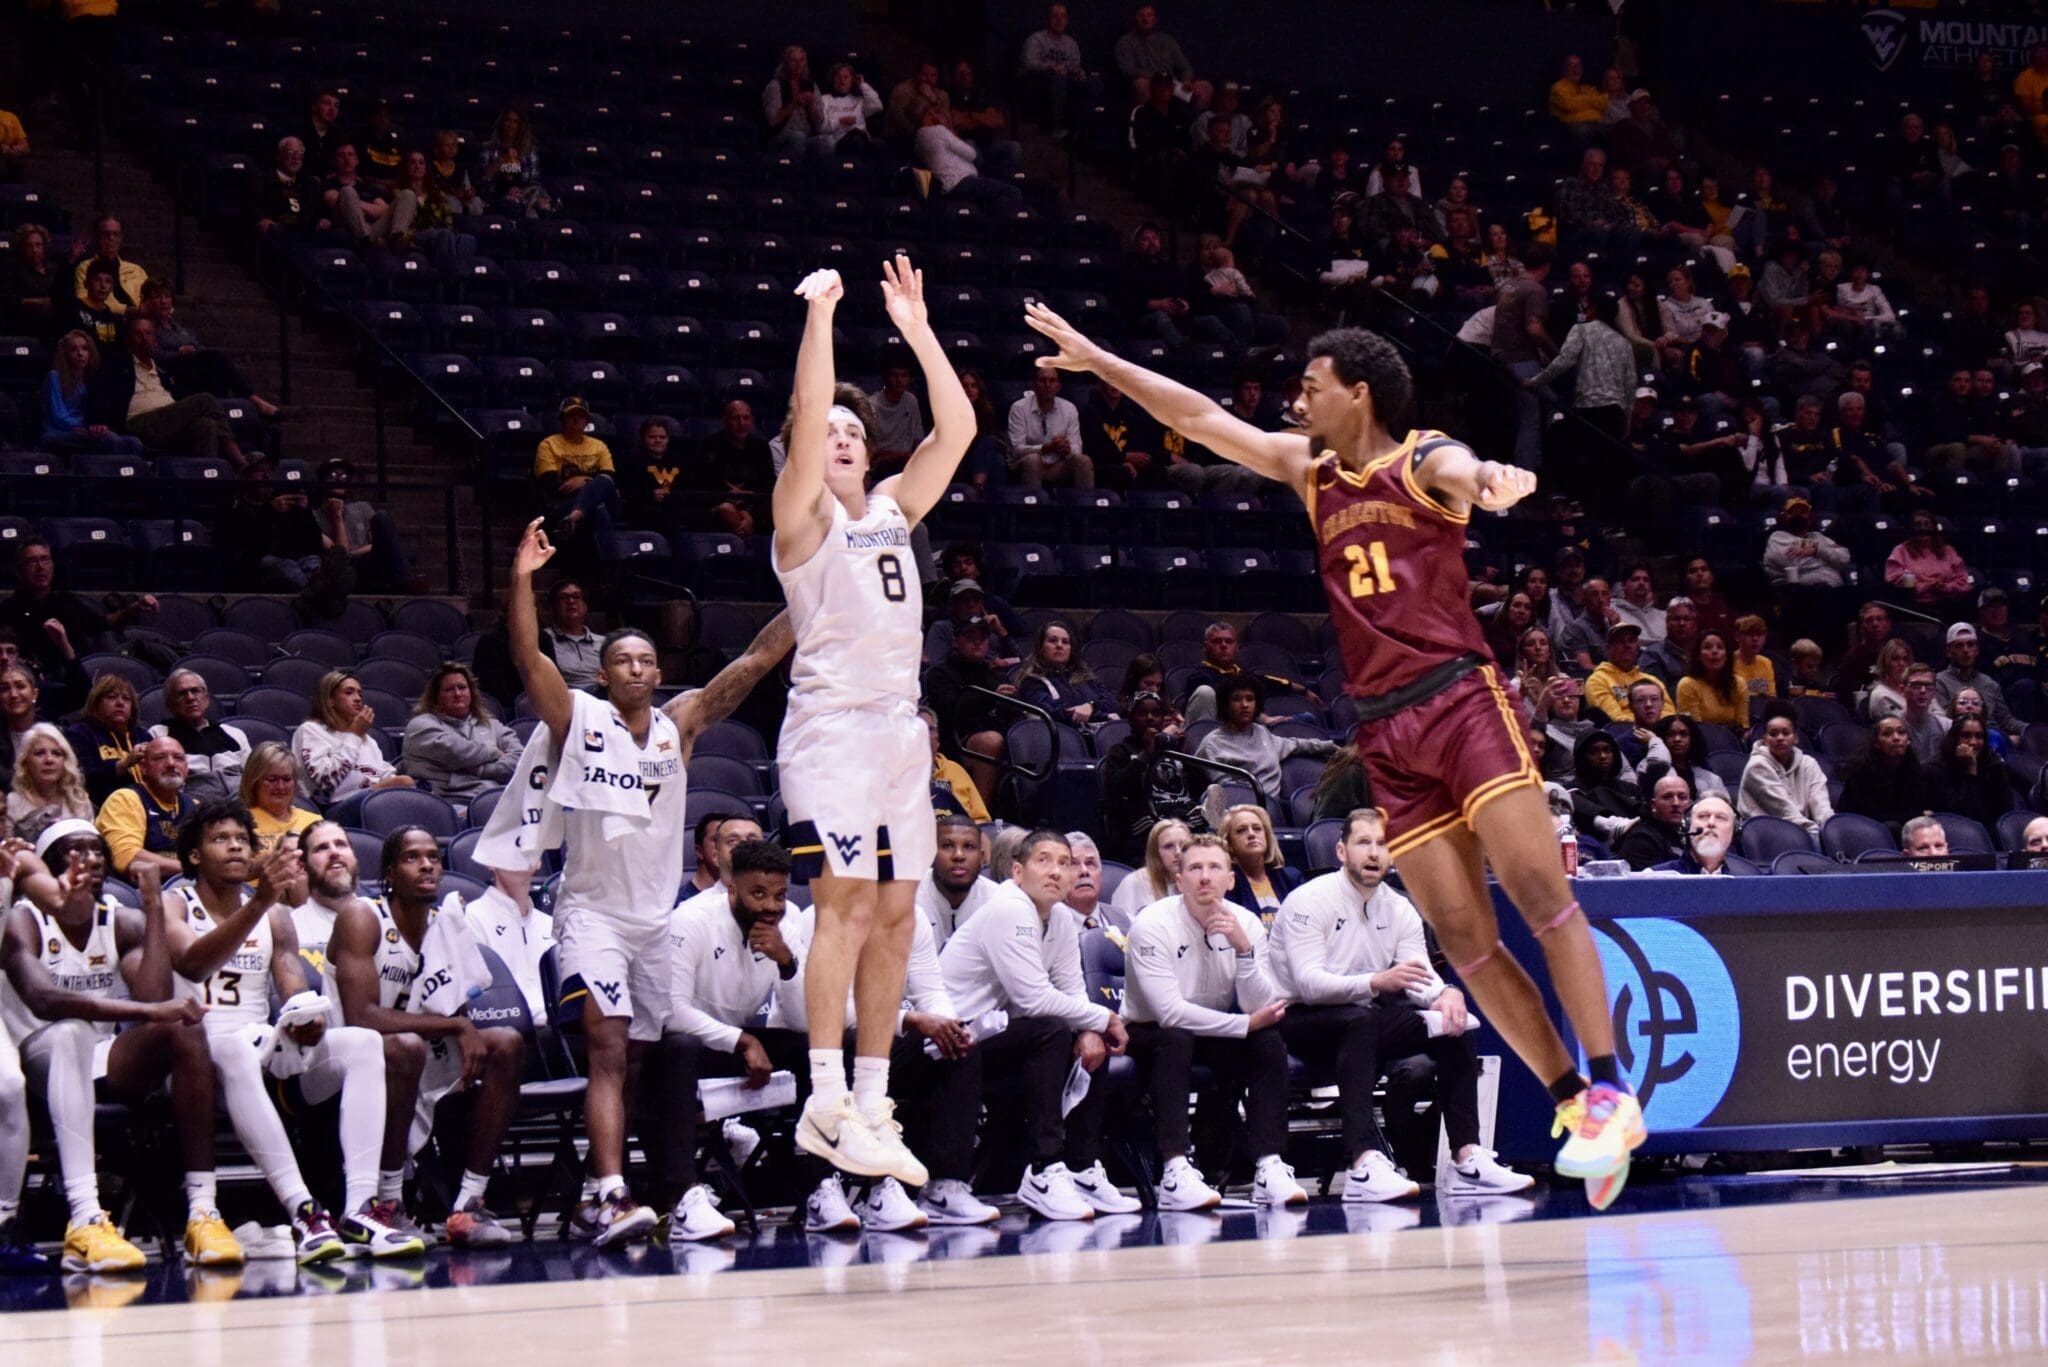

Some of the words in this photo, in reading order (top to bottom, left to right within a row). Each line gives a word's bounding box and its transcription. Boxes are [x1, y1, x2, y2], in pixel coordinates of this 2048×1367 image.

[878, 554, 906, 602] 8
[1343, 541, 1398, 598] 21
[1785, 968, 2048, 1020] DIVERSIFI
[1787, 1038, 1940, 1083] energy
